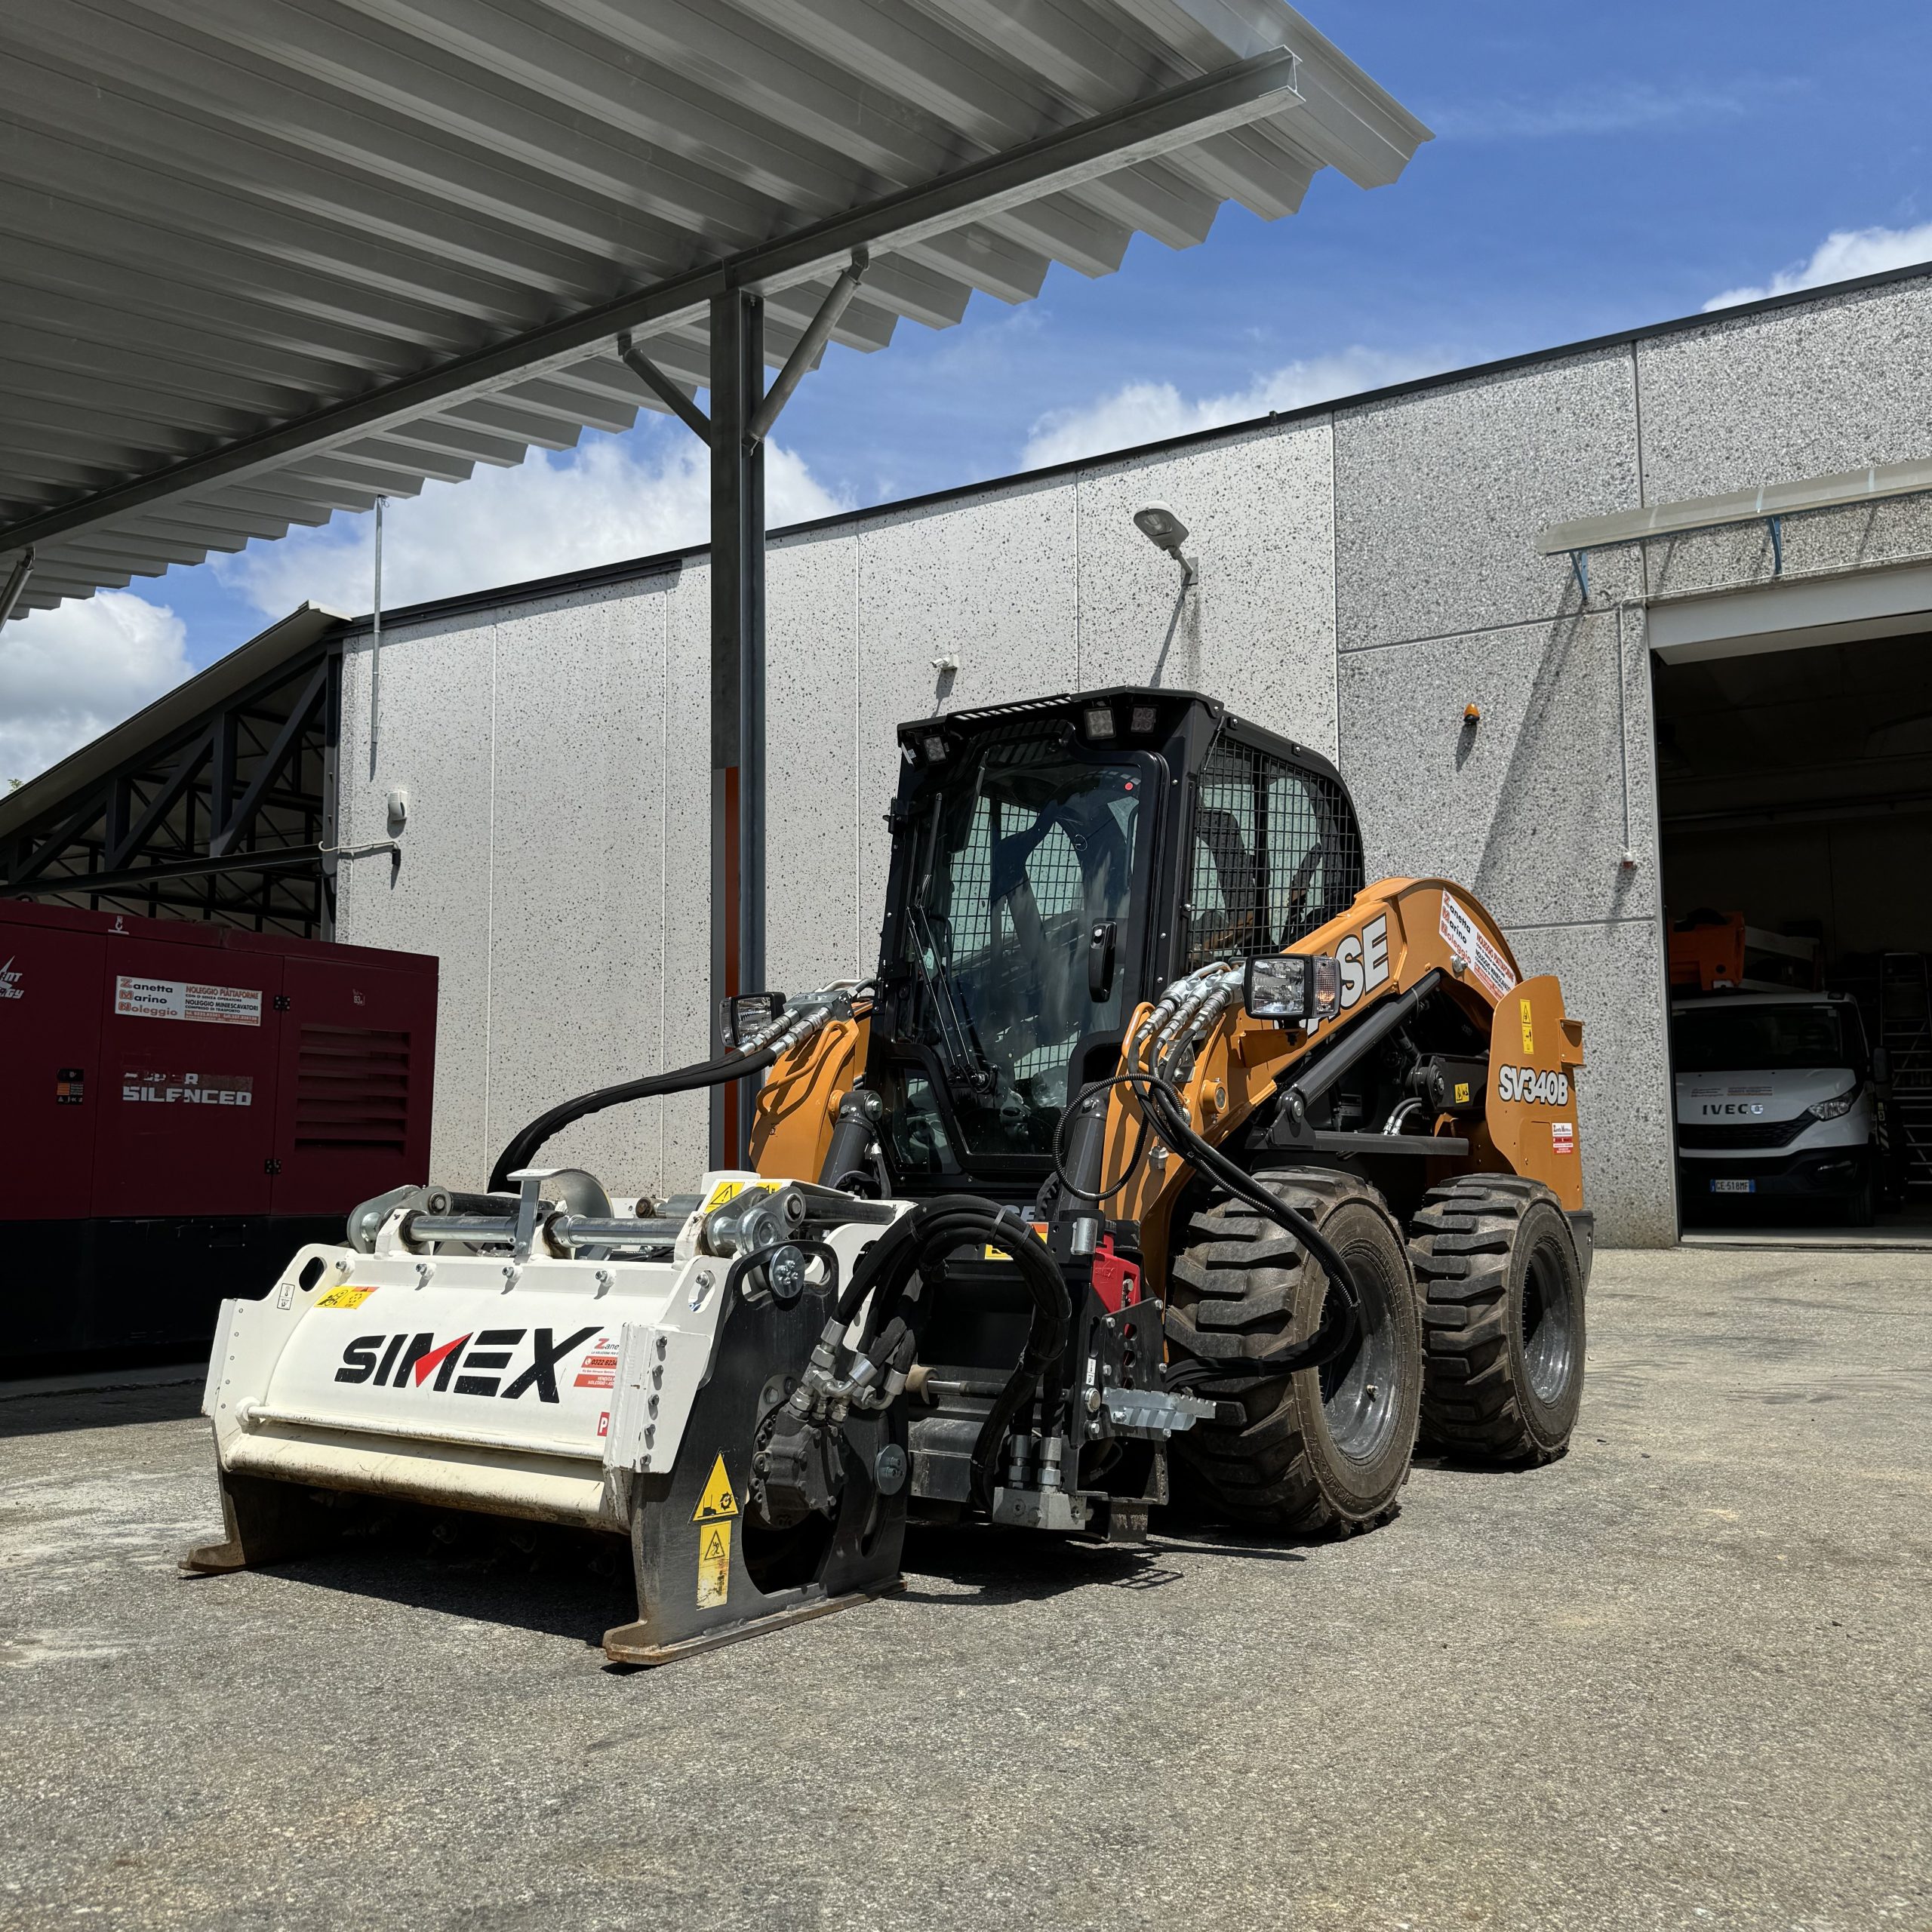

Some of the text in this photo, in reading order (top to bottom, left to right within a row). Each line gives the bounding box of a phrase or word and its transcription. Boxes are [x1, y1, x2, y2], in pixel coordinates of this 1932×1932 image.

[1444, 891, 1471, 934] Zanetta
[1442, 906, 1467, 944] Marino
[1441, 920, 1472, 964] Noleggio
[120, 978, 174, 993] Zanetta
[186, 986, 259, 999] NOLEGGIO PIATTAFORME
[119, 989, 168, 1004] Marino
[118, 1001, 178, 1017] Noleggio
[215, 1001, 258, 1011] MINIESCAVATORI
[1499, 1063, 1568, 1106] SV340B
[122, 1086, 252, 1106] SILENCED
[1703, 1103, 1764, 1115] IVECO
[334, 1326, 605, 1404] SIMEX
[599, 1417, 608, 1433] P
